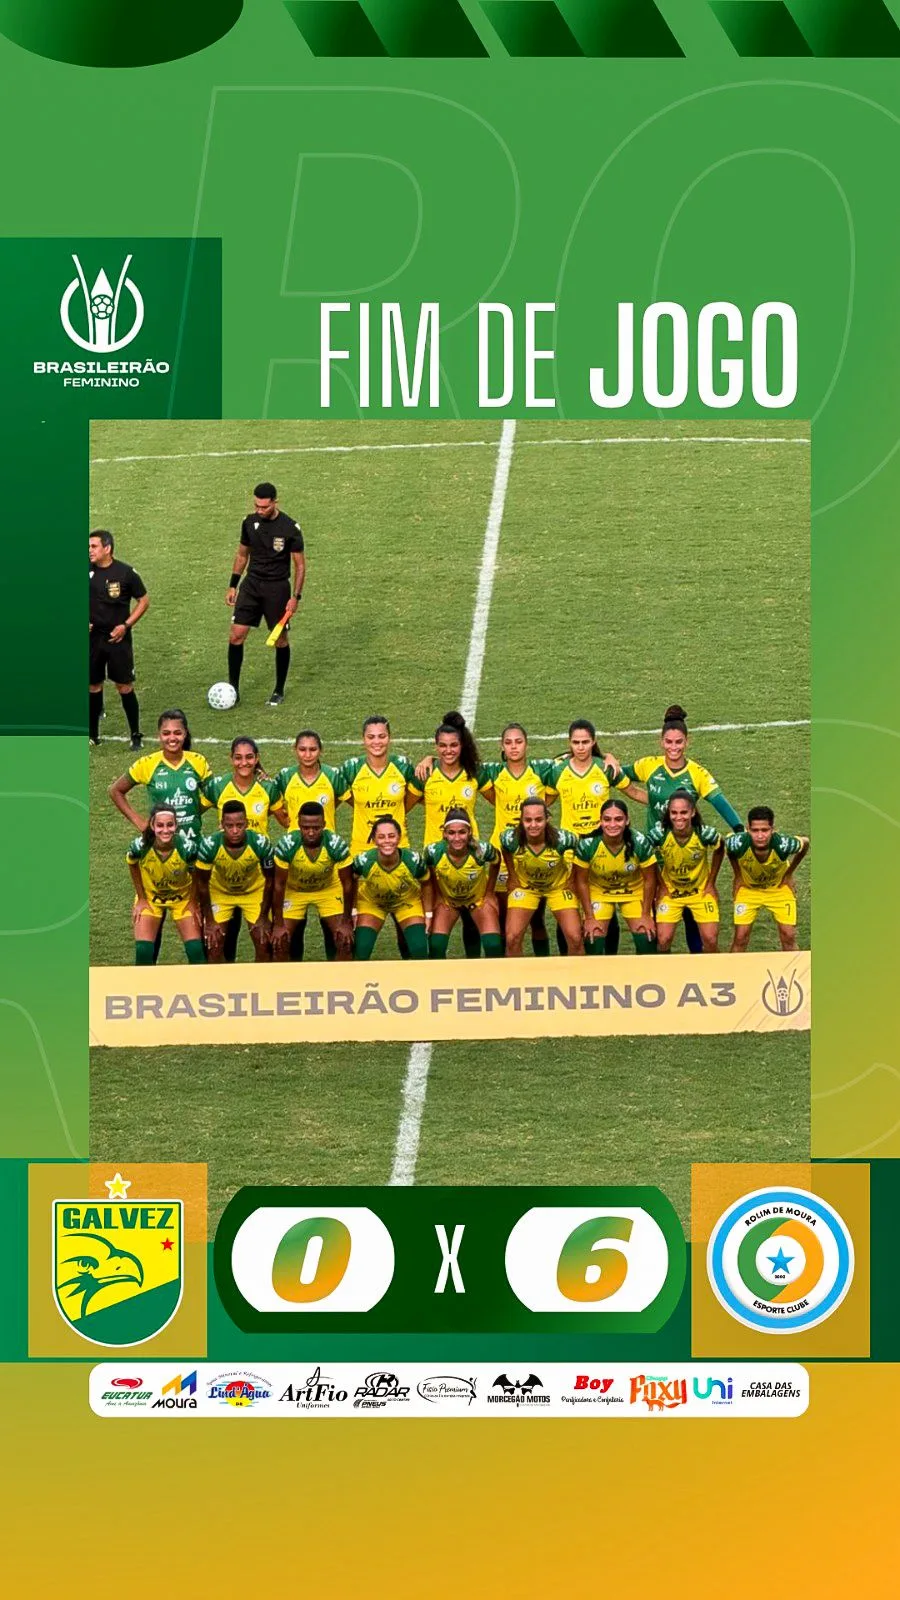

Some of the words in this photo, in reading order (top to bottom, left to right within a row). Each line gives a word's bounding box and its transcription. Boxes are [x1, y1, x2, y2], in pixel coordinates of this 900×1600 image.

[364, 800, 397, 809] ArtFio
[562, 889, 573, 901] 18
[784, 903, 791, 916] 7
[105, 983, 419, 1020] BRASILEIRÃO
[430, 983, 667, 1014] FEMININO
[677, 982, 737, 1007] A3
